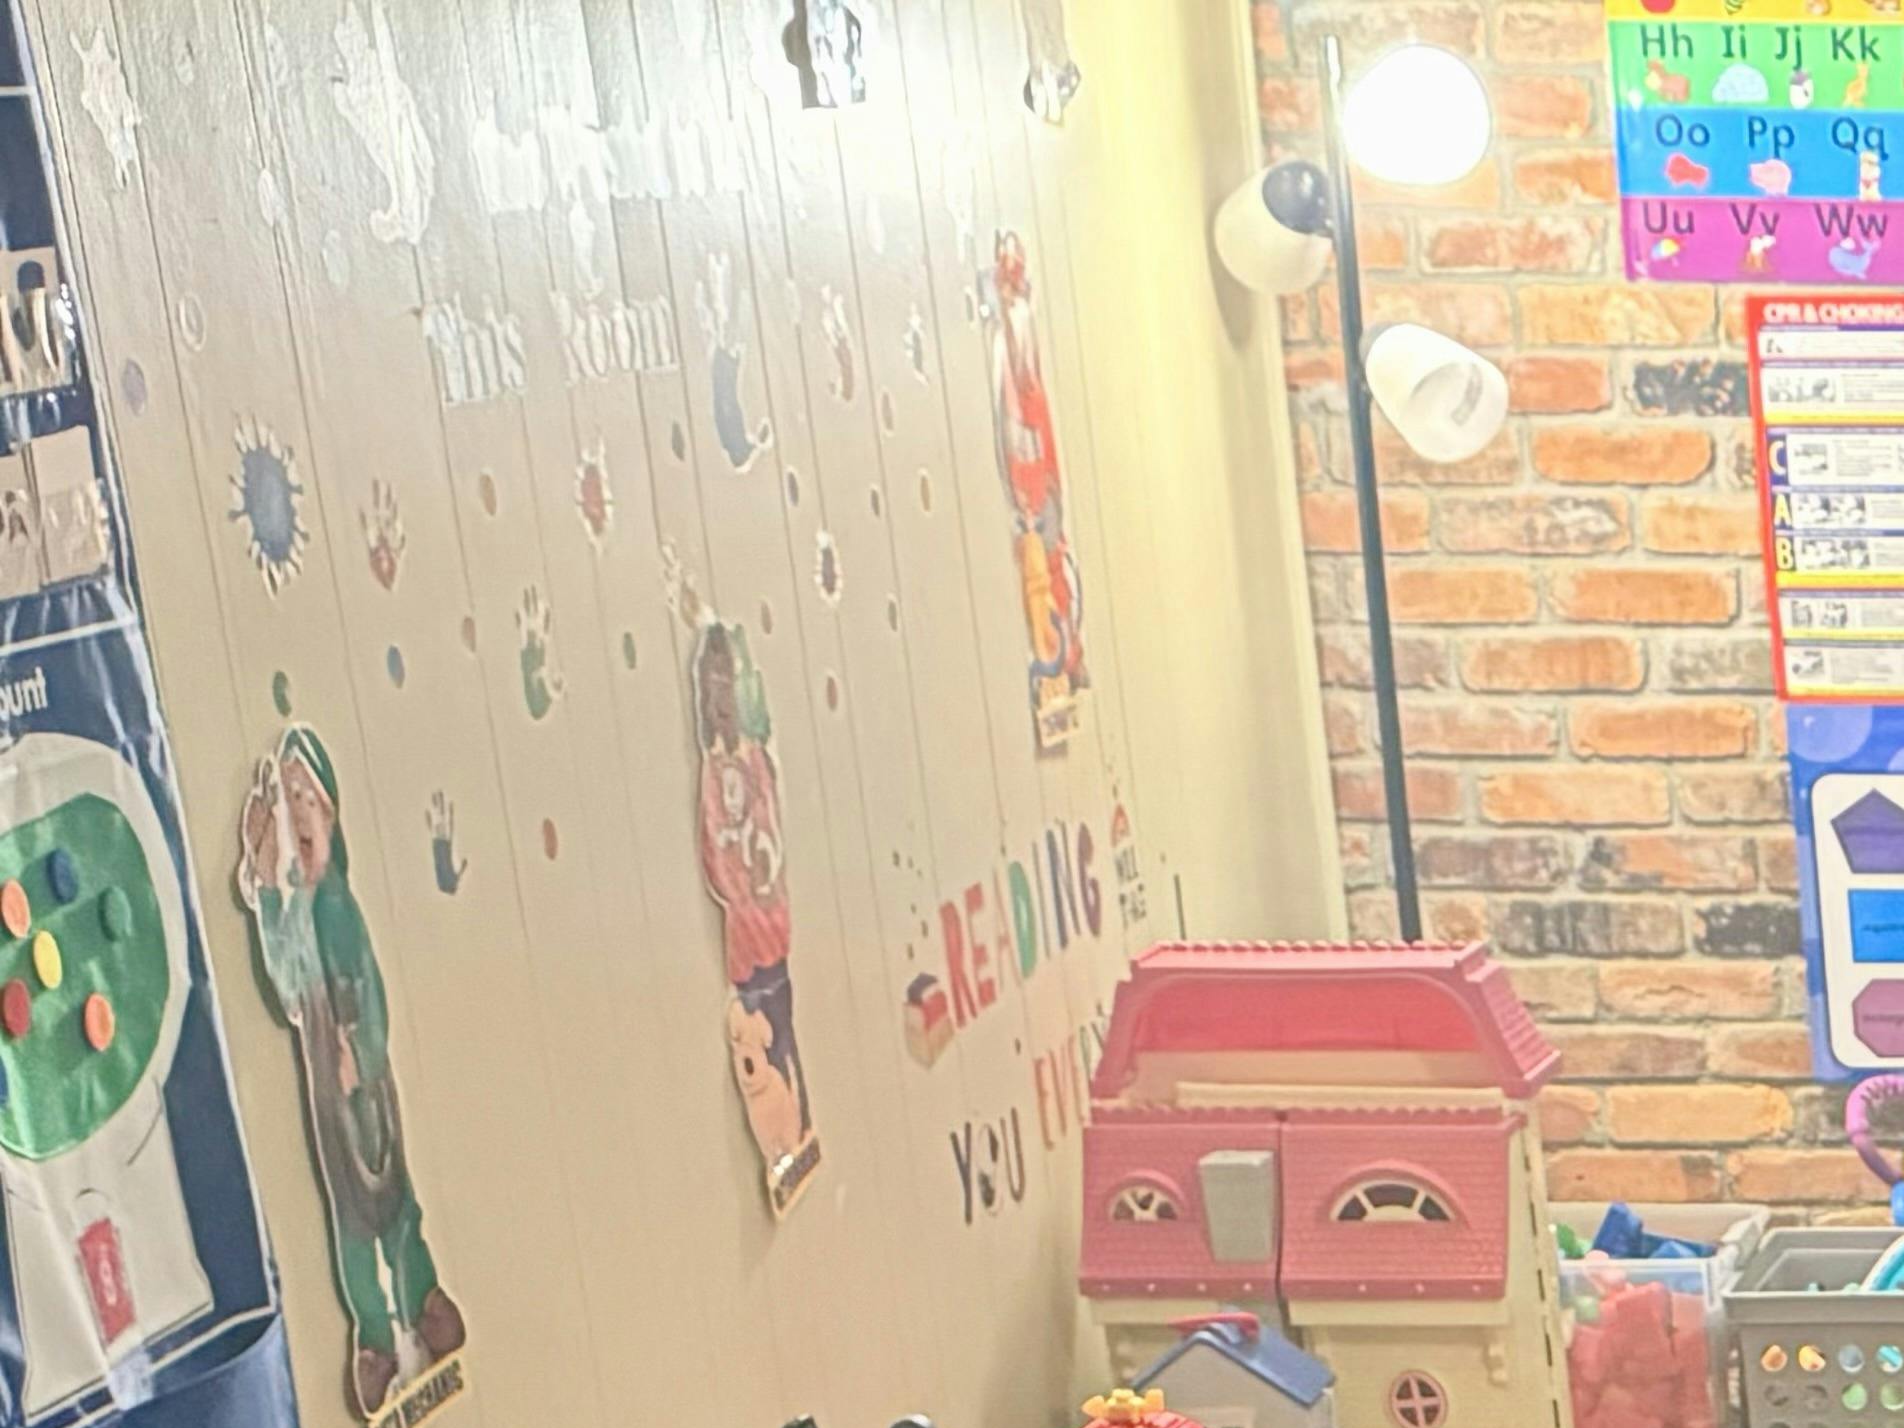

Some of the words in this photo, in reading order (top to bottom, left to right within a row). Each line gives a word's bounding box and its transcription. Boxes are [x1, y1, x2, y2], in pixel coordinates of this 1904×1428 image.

[1640, 26, 1694, 58] Hh
[1721, 26, 1748, 59] Ii
[1774, 26, 1802, 68] Jj
[1831, 27, 1880, 62] Kk
[1655, 114, 1710, 148] Oo
[1747, 116, 1795, 157] Pp
[1831, 117, 1888, 161] Qq
[1643, 204, 1695, 234] Uu
[1729, 205, 1781, 235] Vv
[1812, 206, 1888, 238] Ww
[1768, 442, 1786, 476] C
[1773, 497, 1792, 522] A
[1775, 537, 1795, 570] B
[0, 664, 48, 722] ount
[939, 822, 1100, 1030] READING
